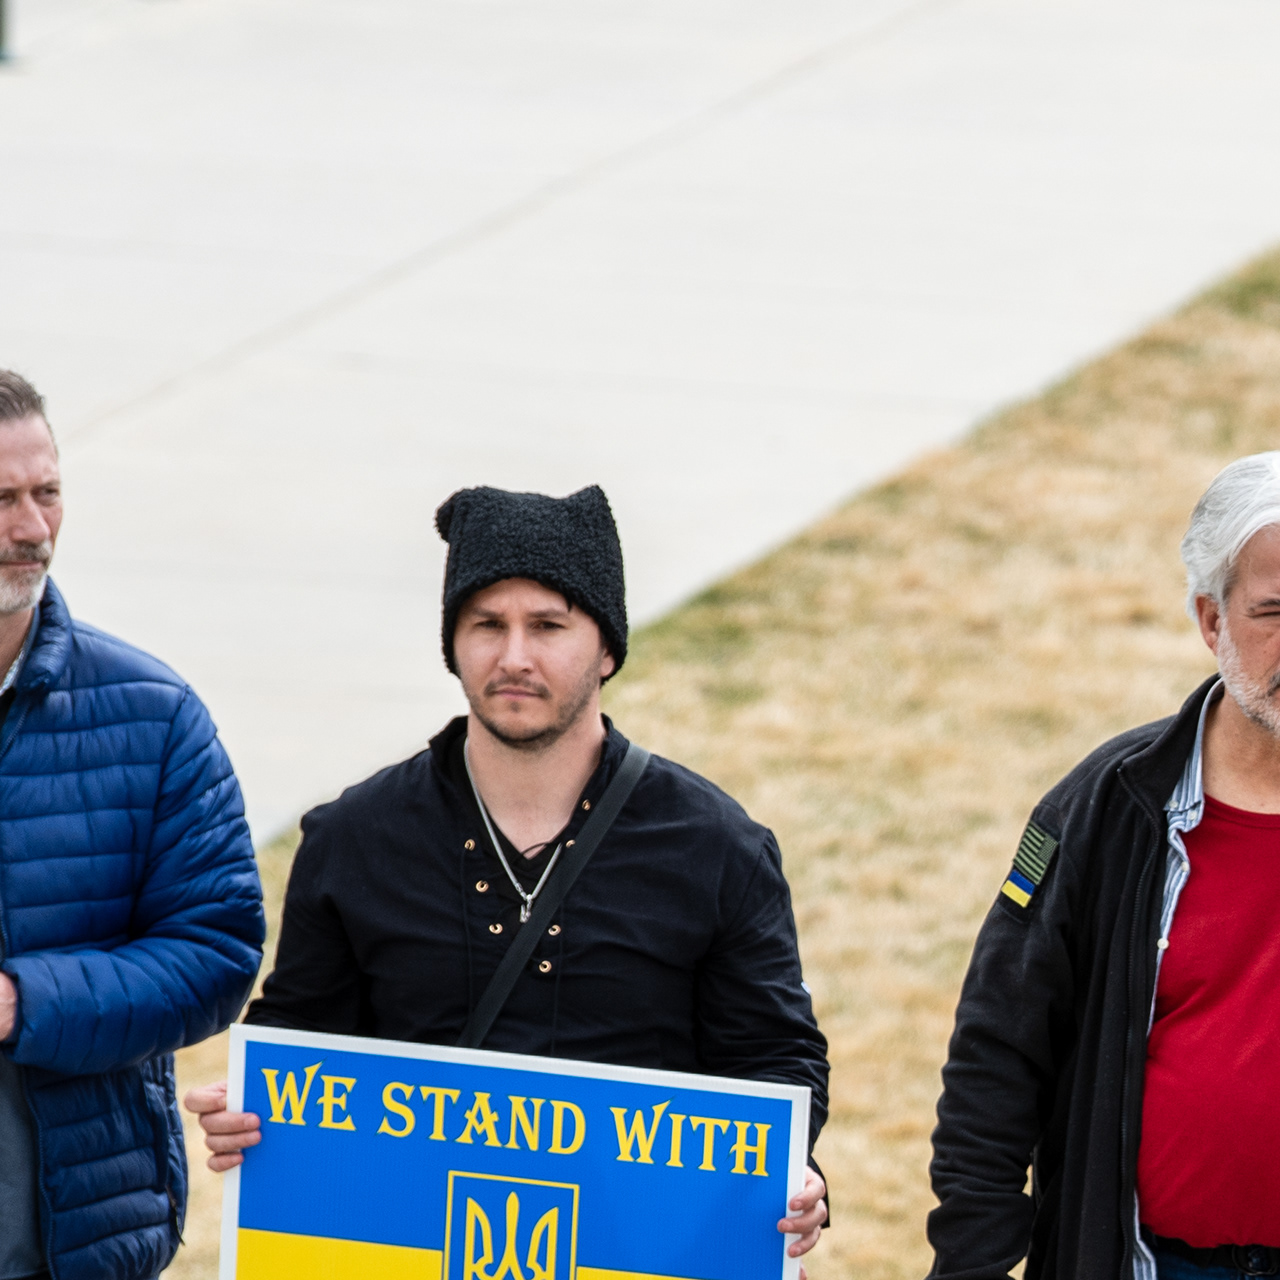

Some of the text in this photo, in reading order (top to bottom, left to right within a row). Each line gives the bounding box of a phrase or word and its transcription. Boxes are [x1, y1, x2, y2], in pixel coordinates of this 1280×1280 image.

[261, 1061, 772, 1177] WE STAND WITH
